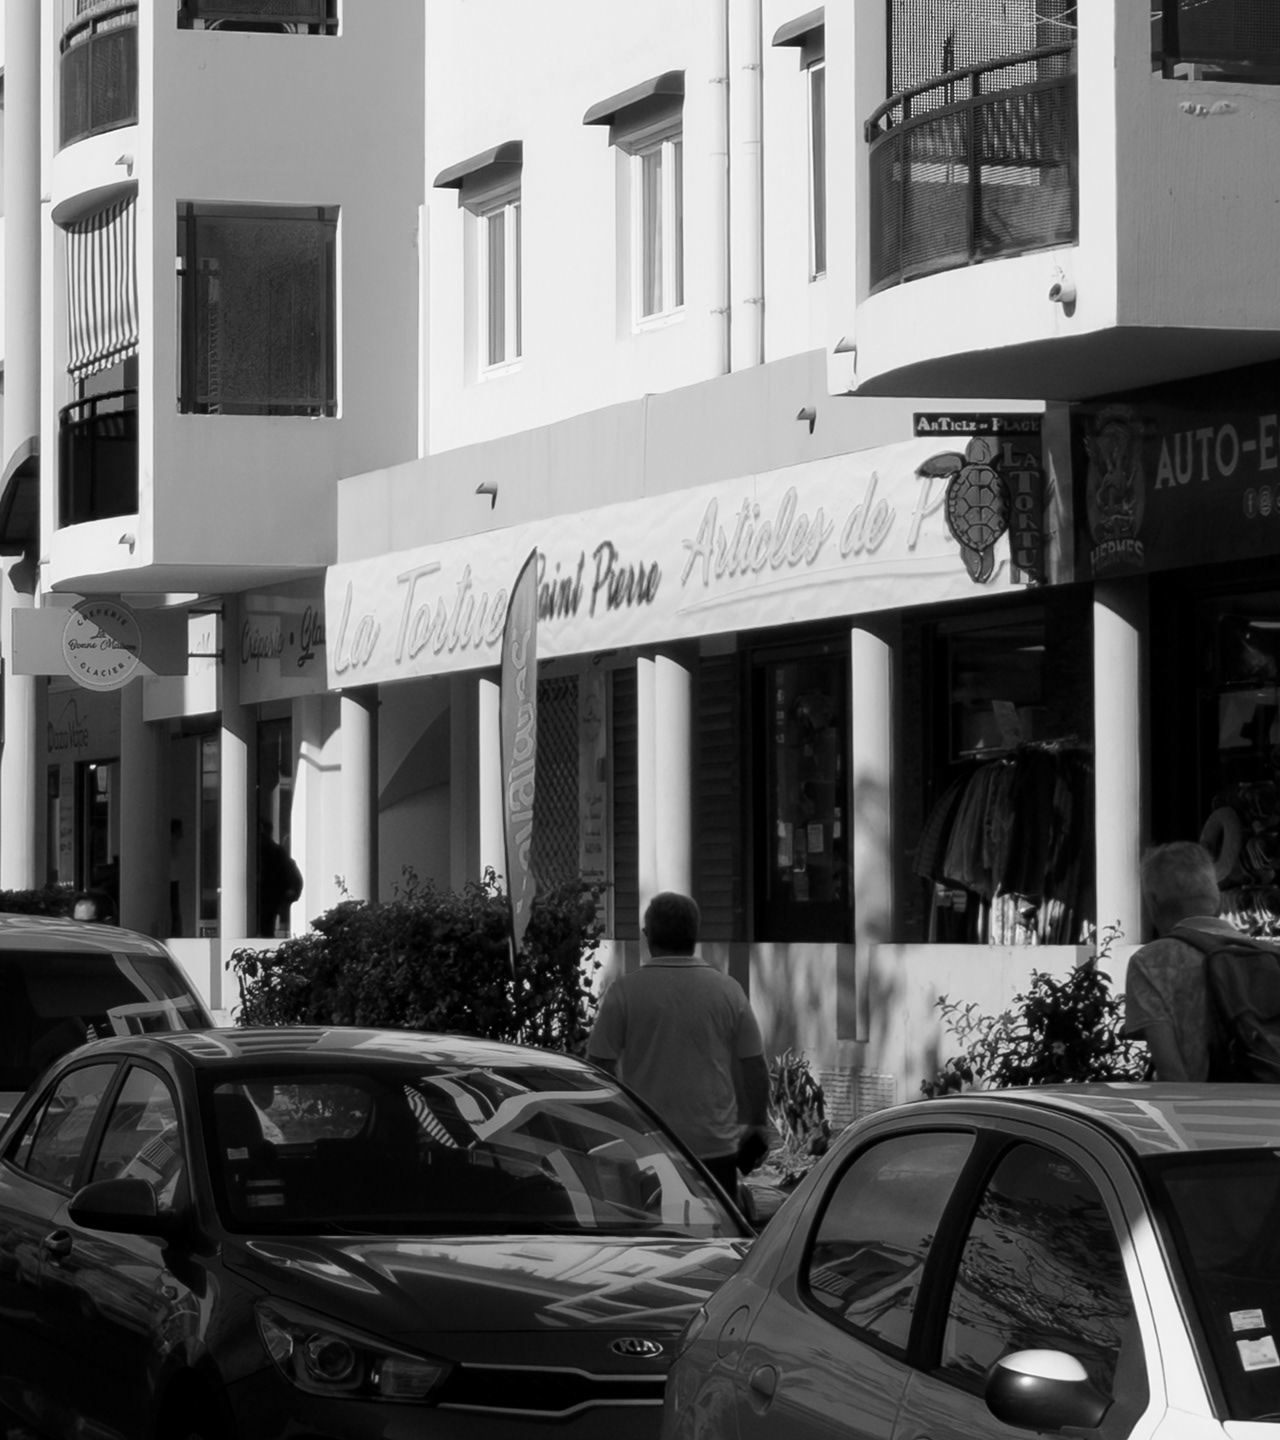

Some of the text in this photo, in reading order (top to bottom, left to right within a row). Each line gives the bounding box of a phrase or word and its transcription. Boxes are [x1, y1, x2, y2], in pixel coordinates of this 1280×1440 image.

[1090, 539, 1145, 577] HERMES
[335, 580, 382, 675] La
[396, 561, 511, 664] Tortue
[589, 539, 662, 619] Pierre
[680, 486, 836, 588] Articles
[839, 470, 897, 559] de
[80, 662, 125, 678] GLACIER
[619, 1339, 657, 1352] KIA
